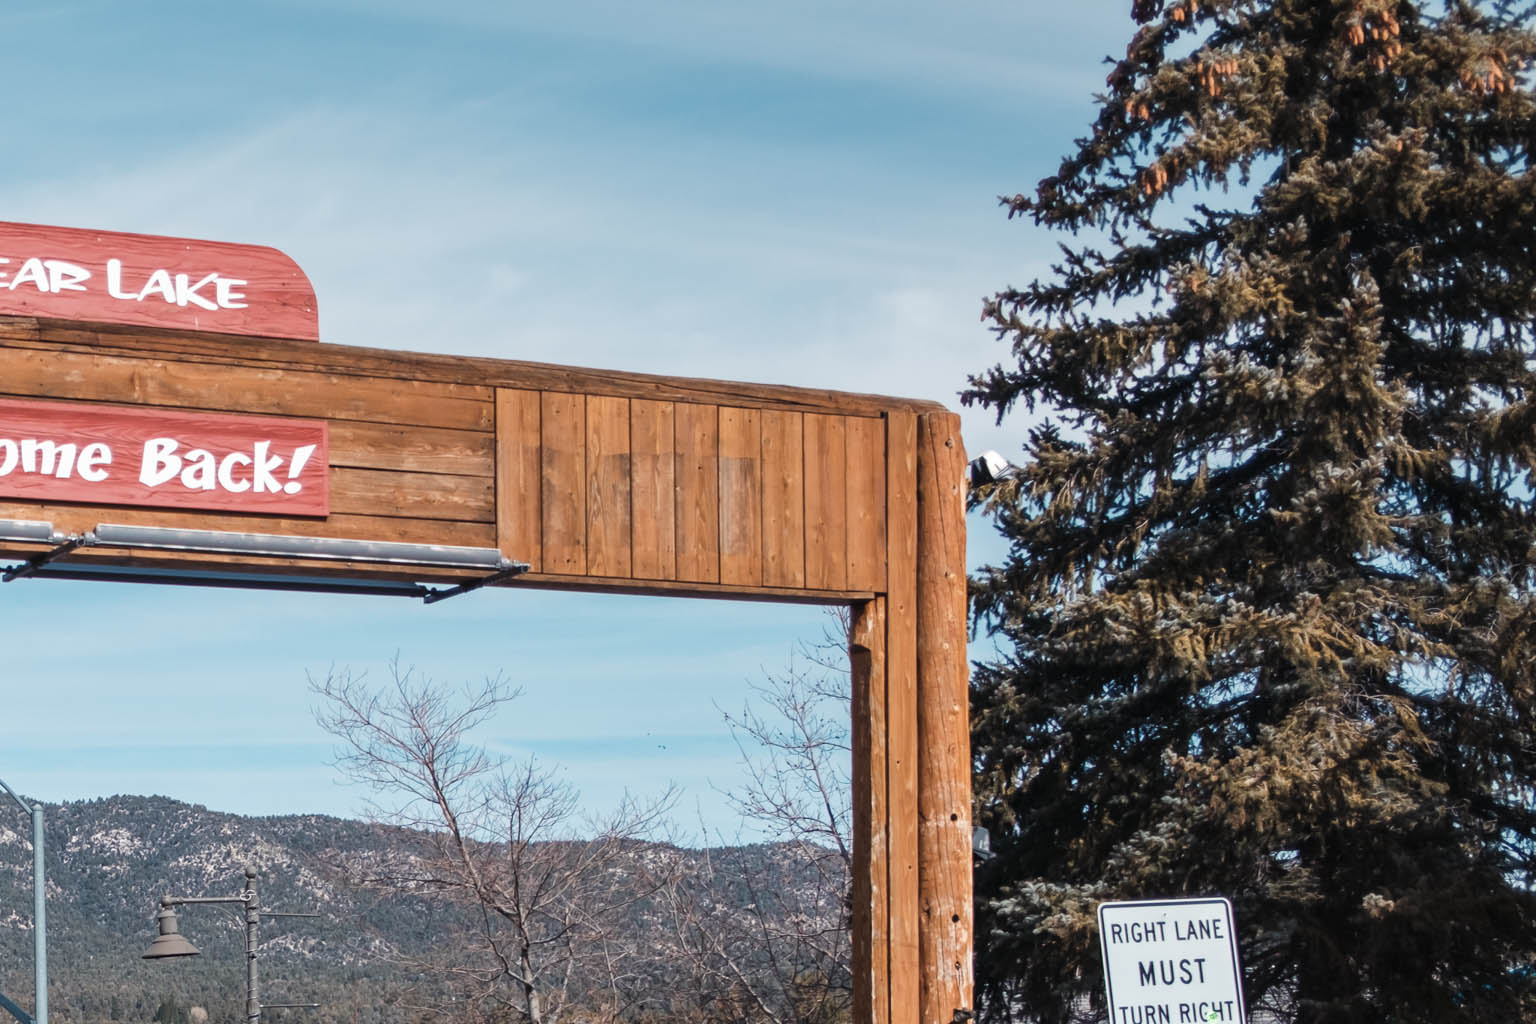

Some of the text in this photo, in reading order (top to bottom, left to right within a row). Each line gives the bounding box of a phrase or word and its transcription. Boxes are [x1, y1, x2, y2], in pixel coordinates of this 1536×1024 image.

[107, 259, 249, 311] LAKE
[138, 437, 317, 494] Back!
[1110, 918, 1225, 945] RIGHT LANE
[1138, 957, 1206, 987] MUST
[1178, 1000, 1234, 1024] RIGHT
